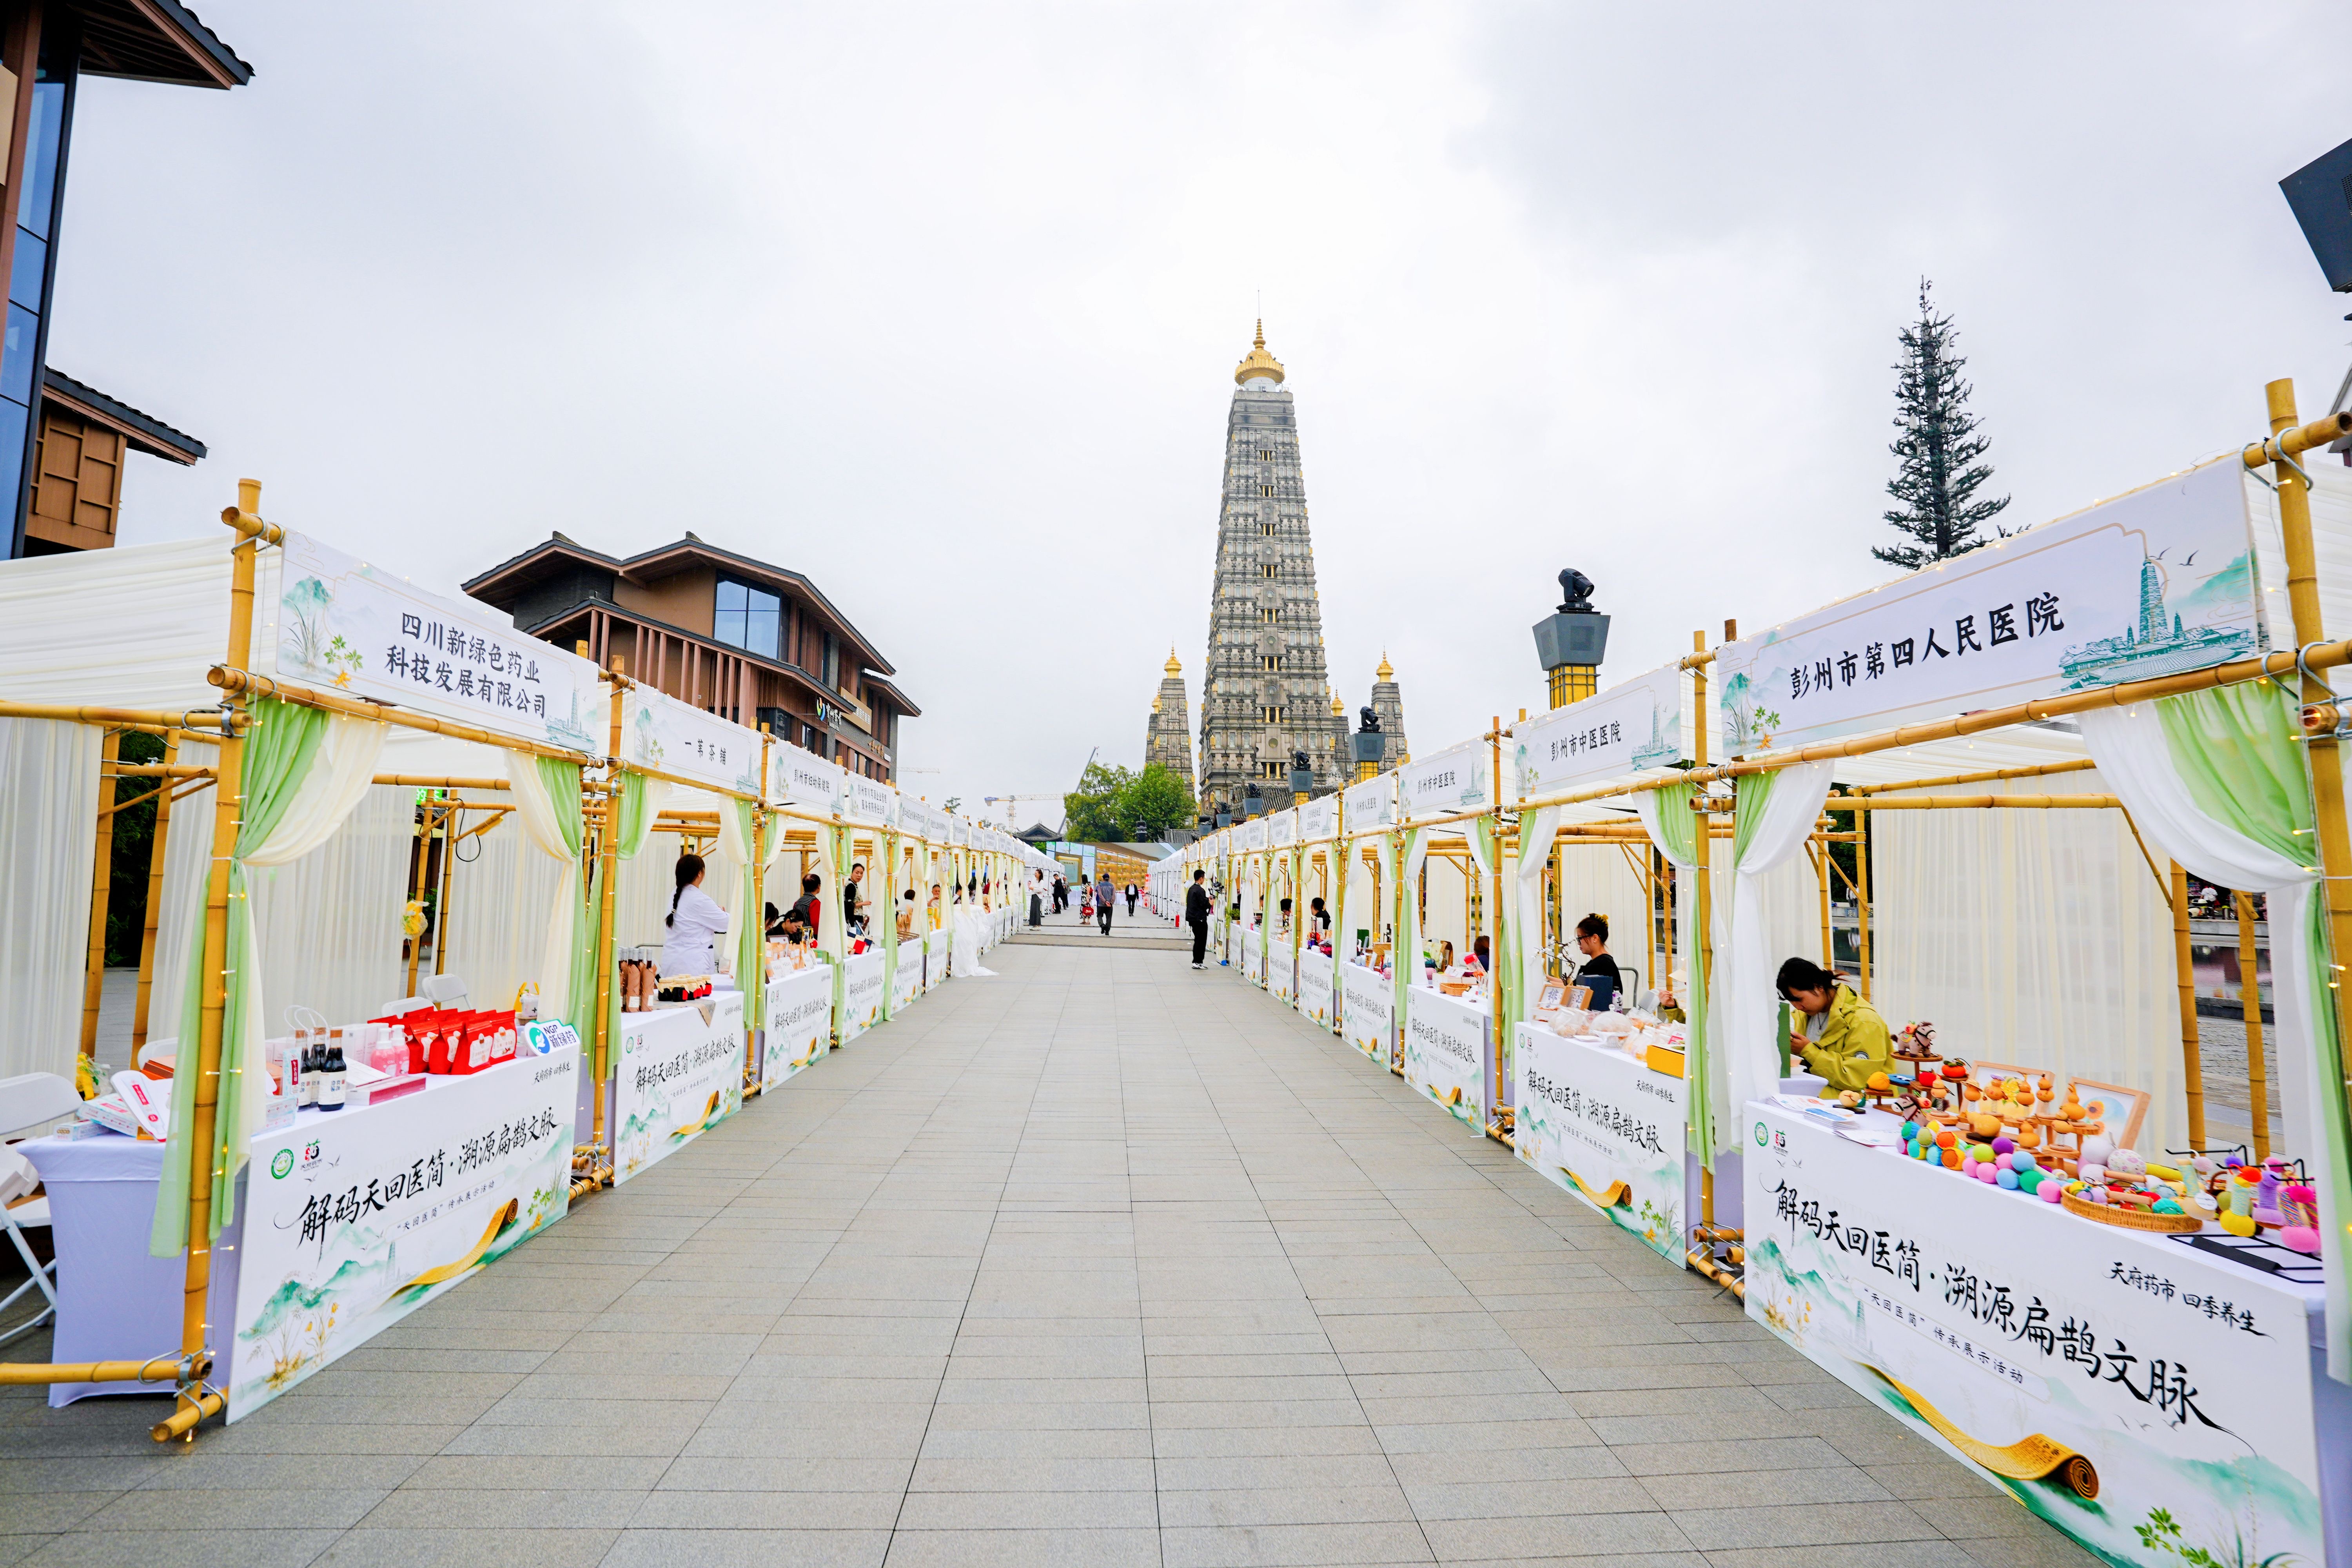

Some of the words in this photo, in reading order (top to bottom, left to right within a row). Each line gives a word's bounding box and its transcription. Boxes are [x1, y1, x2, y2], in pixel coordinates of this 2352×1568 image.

[386, 644, 545, 720] 科技发展有限公司
[401, 612, 540, 684] 四川新绿色药业
[1791, 592, 2065, 700] 彭州市第四人民医院
[1551, 720, 1621, 762] 彭州市中医医院
[794, 768, 830, 793] 彭州市妇幼保健院
[1417, 769, 1455, 795] 彭州市中医医院
[543, 1024, 558, 1034] NGP
[549, 1030, 577, 1048] 新绿药
[1521, 1064, 1671, 1160] 解码天回医简·溯源扁鹊文脉
[274, 1106, 564, 1270] 解码天回医简·溯源扁鹊文脉
[1759, 1172, 2259, 1461] 解码天回医简·溯源扁鹊文脉
[2102, 1261, 2176, 1305] 天府药市
[2182, 1295, 2277, 1343] 四季养生
